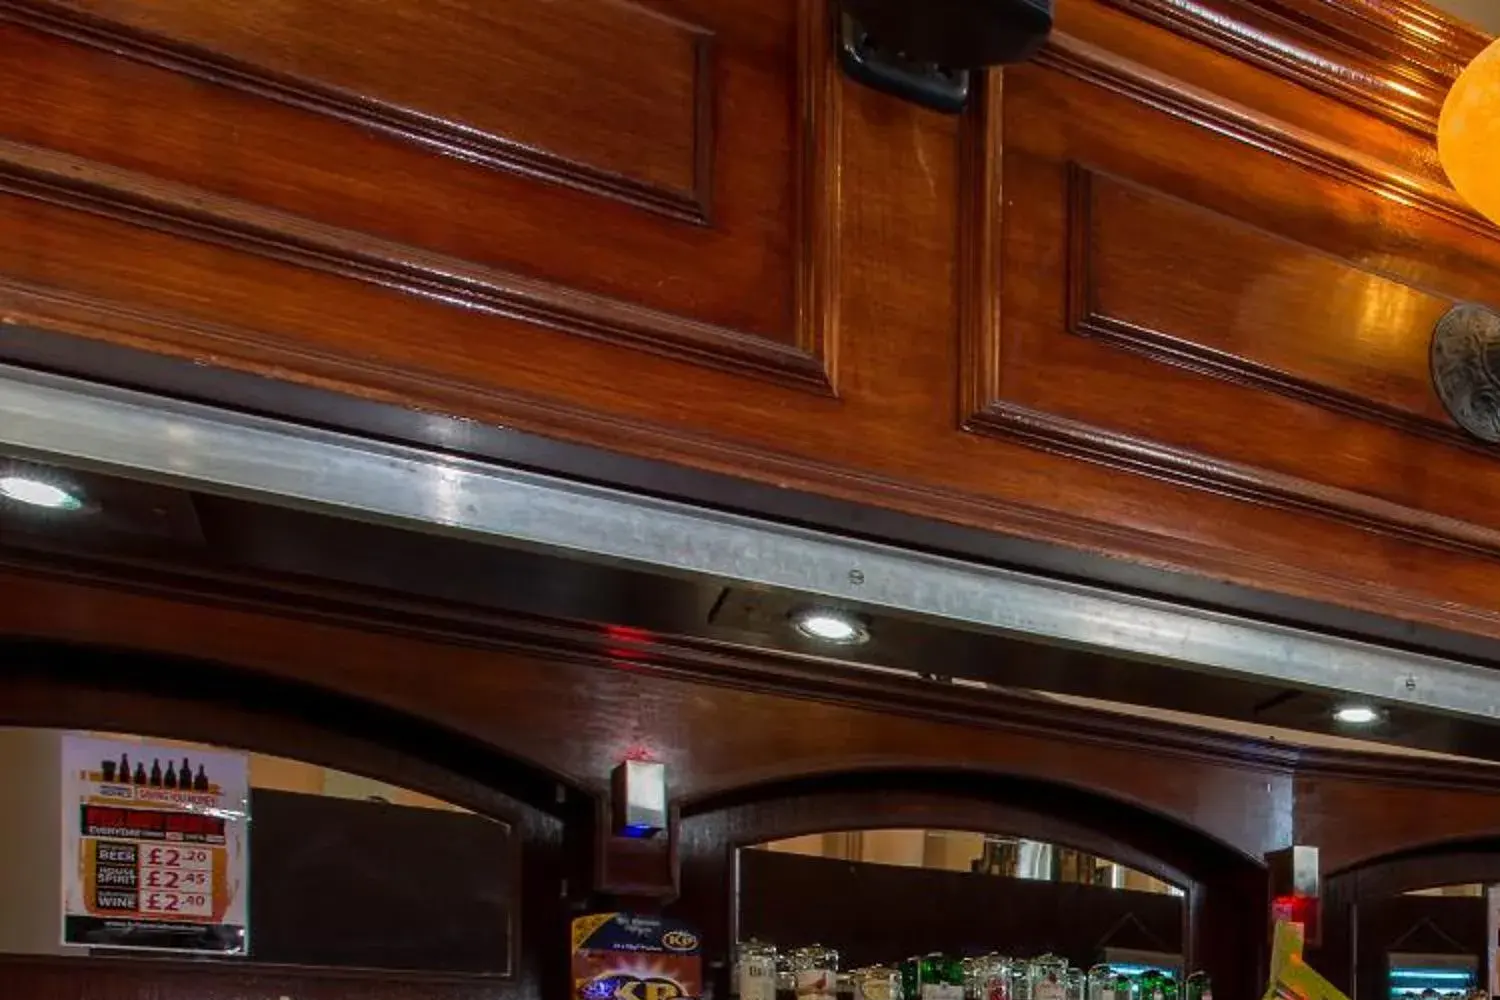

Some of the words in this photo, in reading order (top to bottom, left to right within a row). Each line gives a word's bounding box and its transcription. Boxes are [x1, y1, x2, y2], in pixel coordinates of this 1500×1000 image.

[98, 848, 136, 862] BEER
[148, 847, 207, 866] £2.20
[98, 866, 135, 875] HOUSE
[97, 873, 137, 886] SPIRIT
[98, 895, 137, 908] WINE
